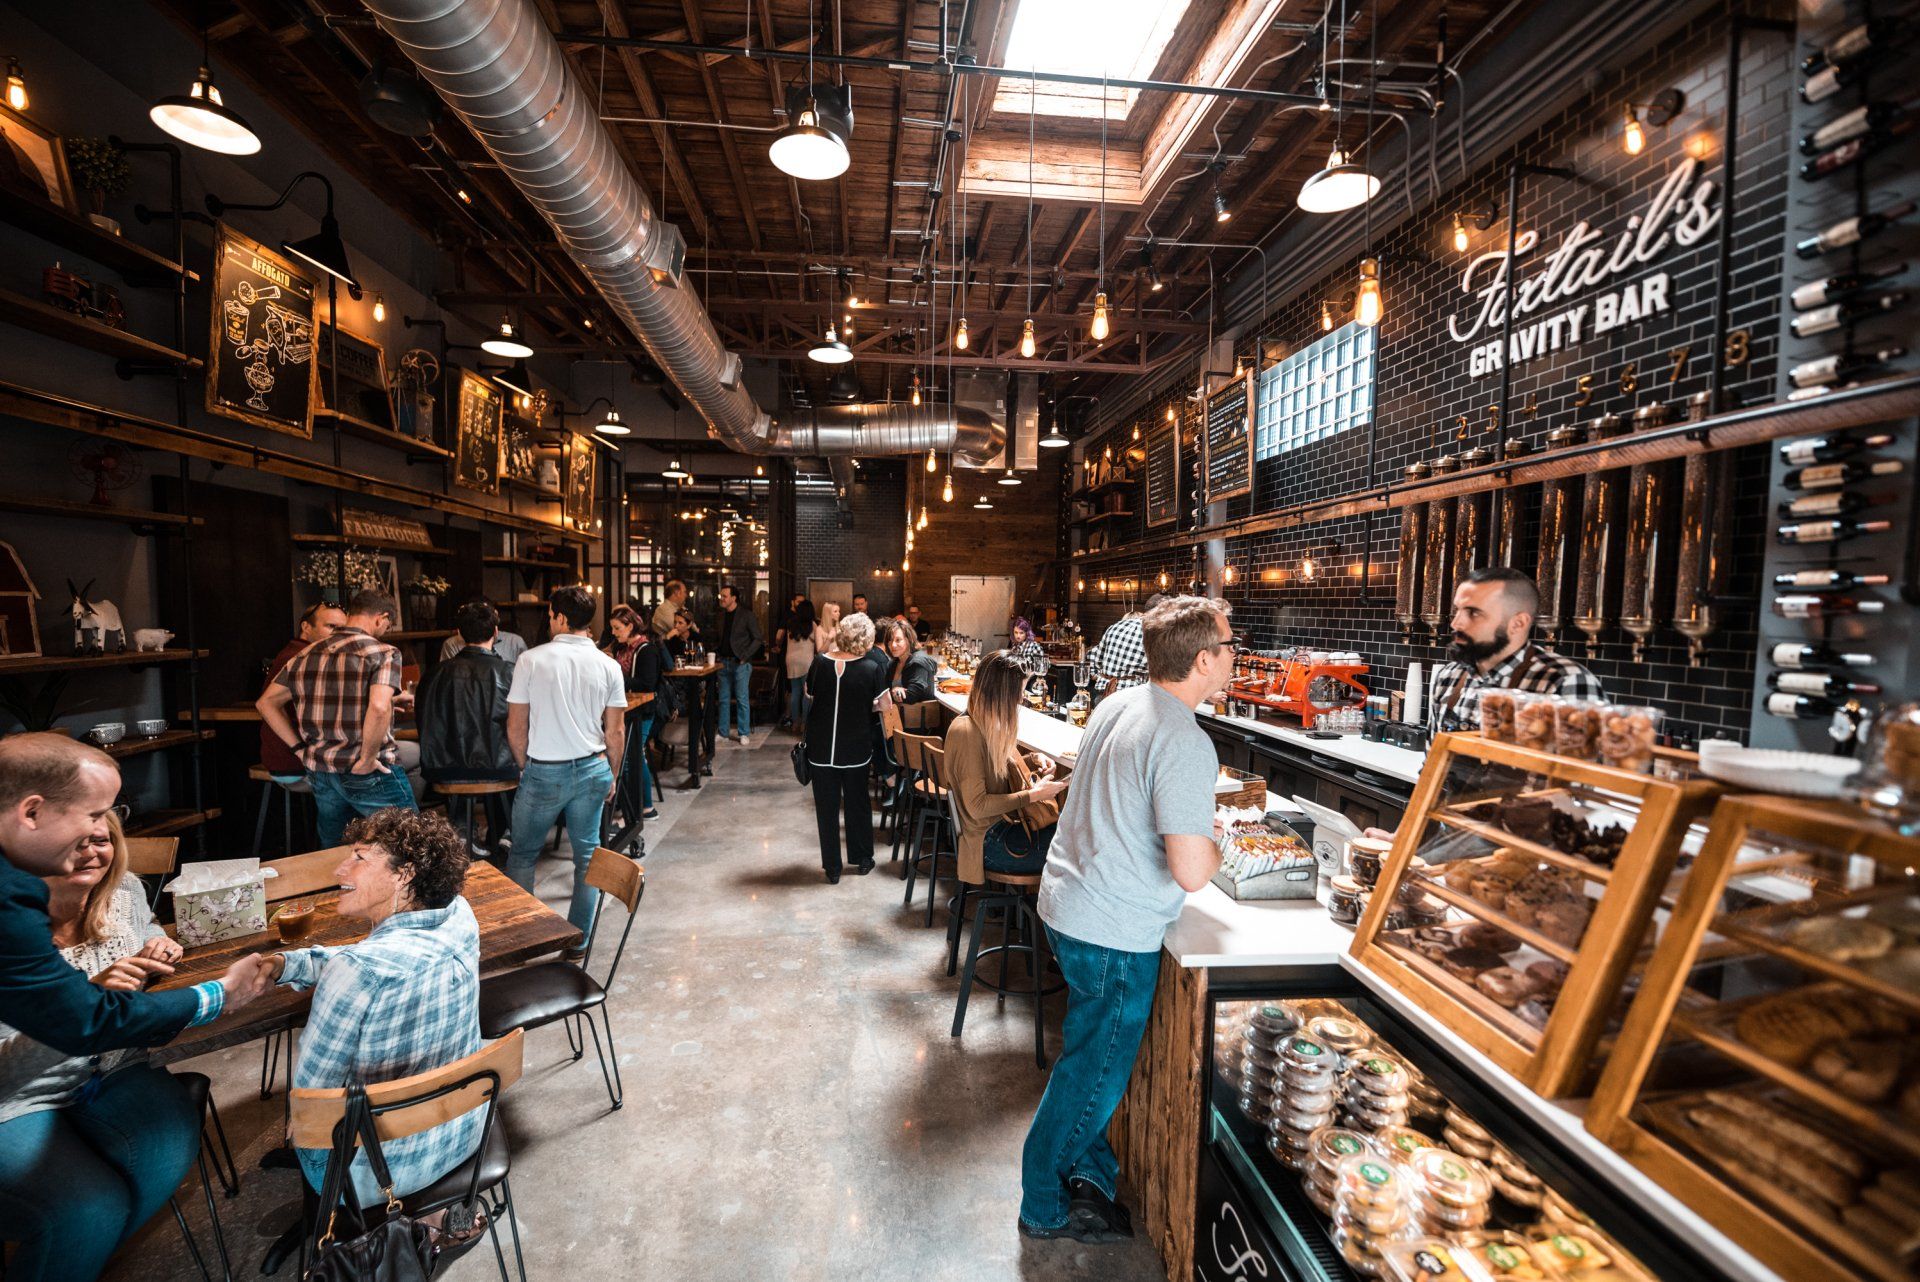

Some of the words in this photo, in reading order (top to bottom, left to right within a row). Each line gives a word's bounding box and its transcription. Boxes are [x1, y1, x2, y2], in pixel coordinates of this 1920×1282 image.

[251, 258, 290, 287] AFFOGATO
[1449, 158, 1723, 342] Foxtail's
[1469, 305, 1589, 378] GRAVITY
[1596, 273, 1669, 334] BAR
[1456, 416, 1468, 440] 2
[1486, 405, 1499, 432] 3
[1575, 375, 1594, 407] 5
[1619, 363, 1637, 395] 6
[1668, 346, 1691, 383] 7
[1724, 330, 1750, 366] 8
[343, 519, 429, 546] FARMHOUSE
